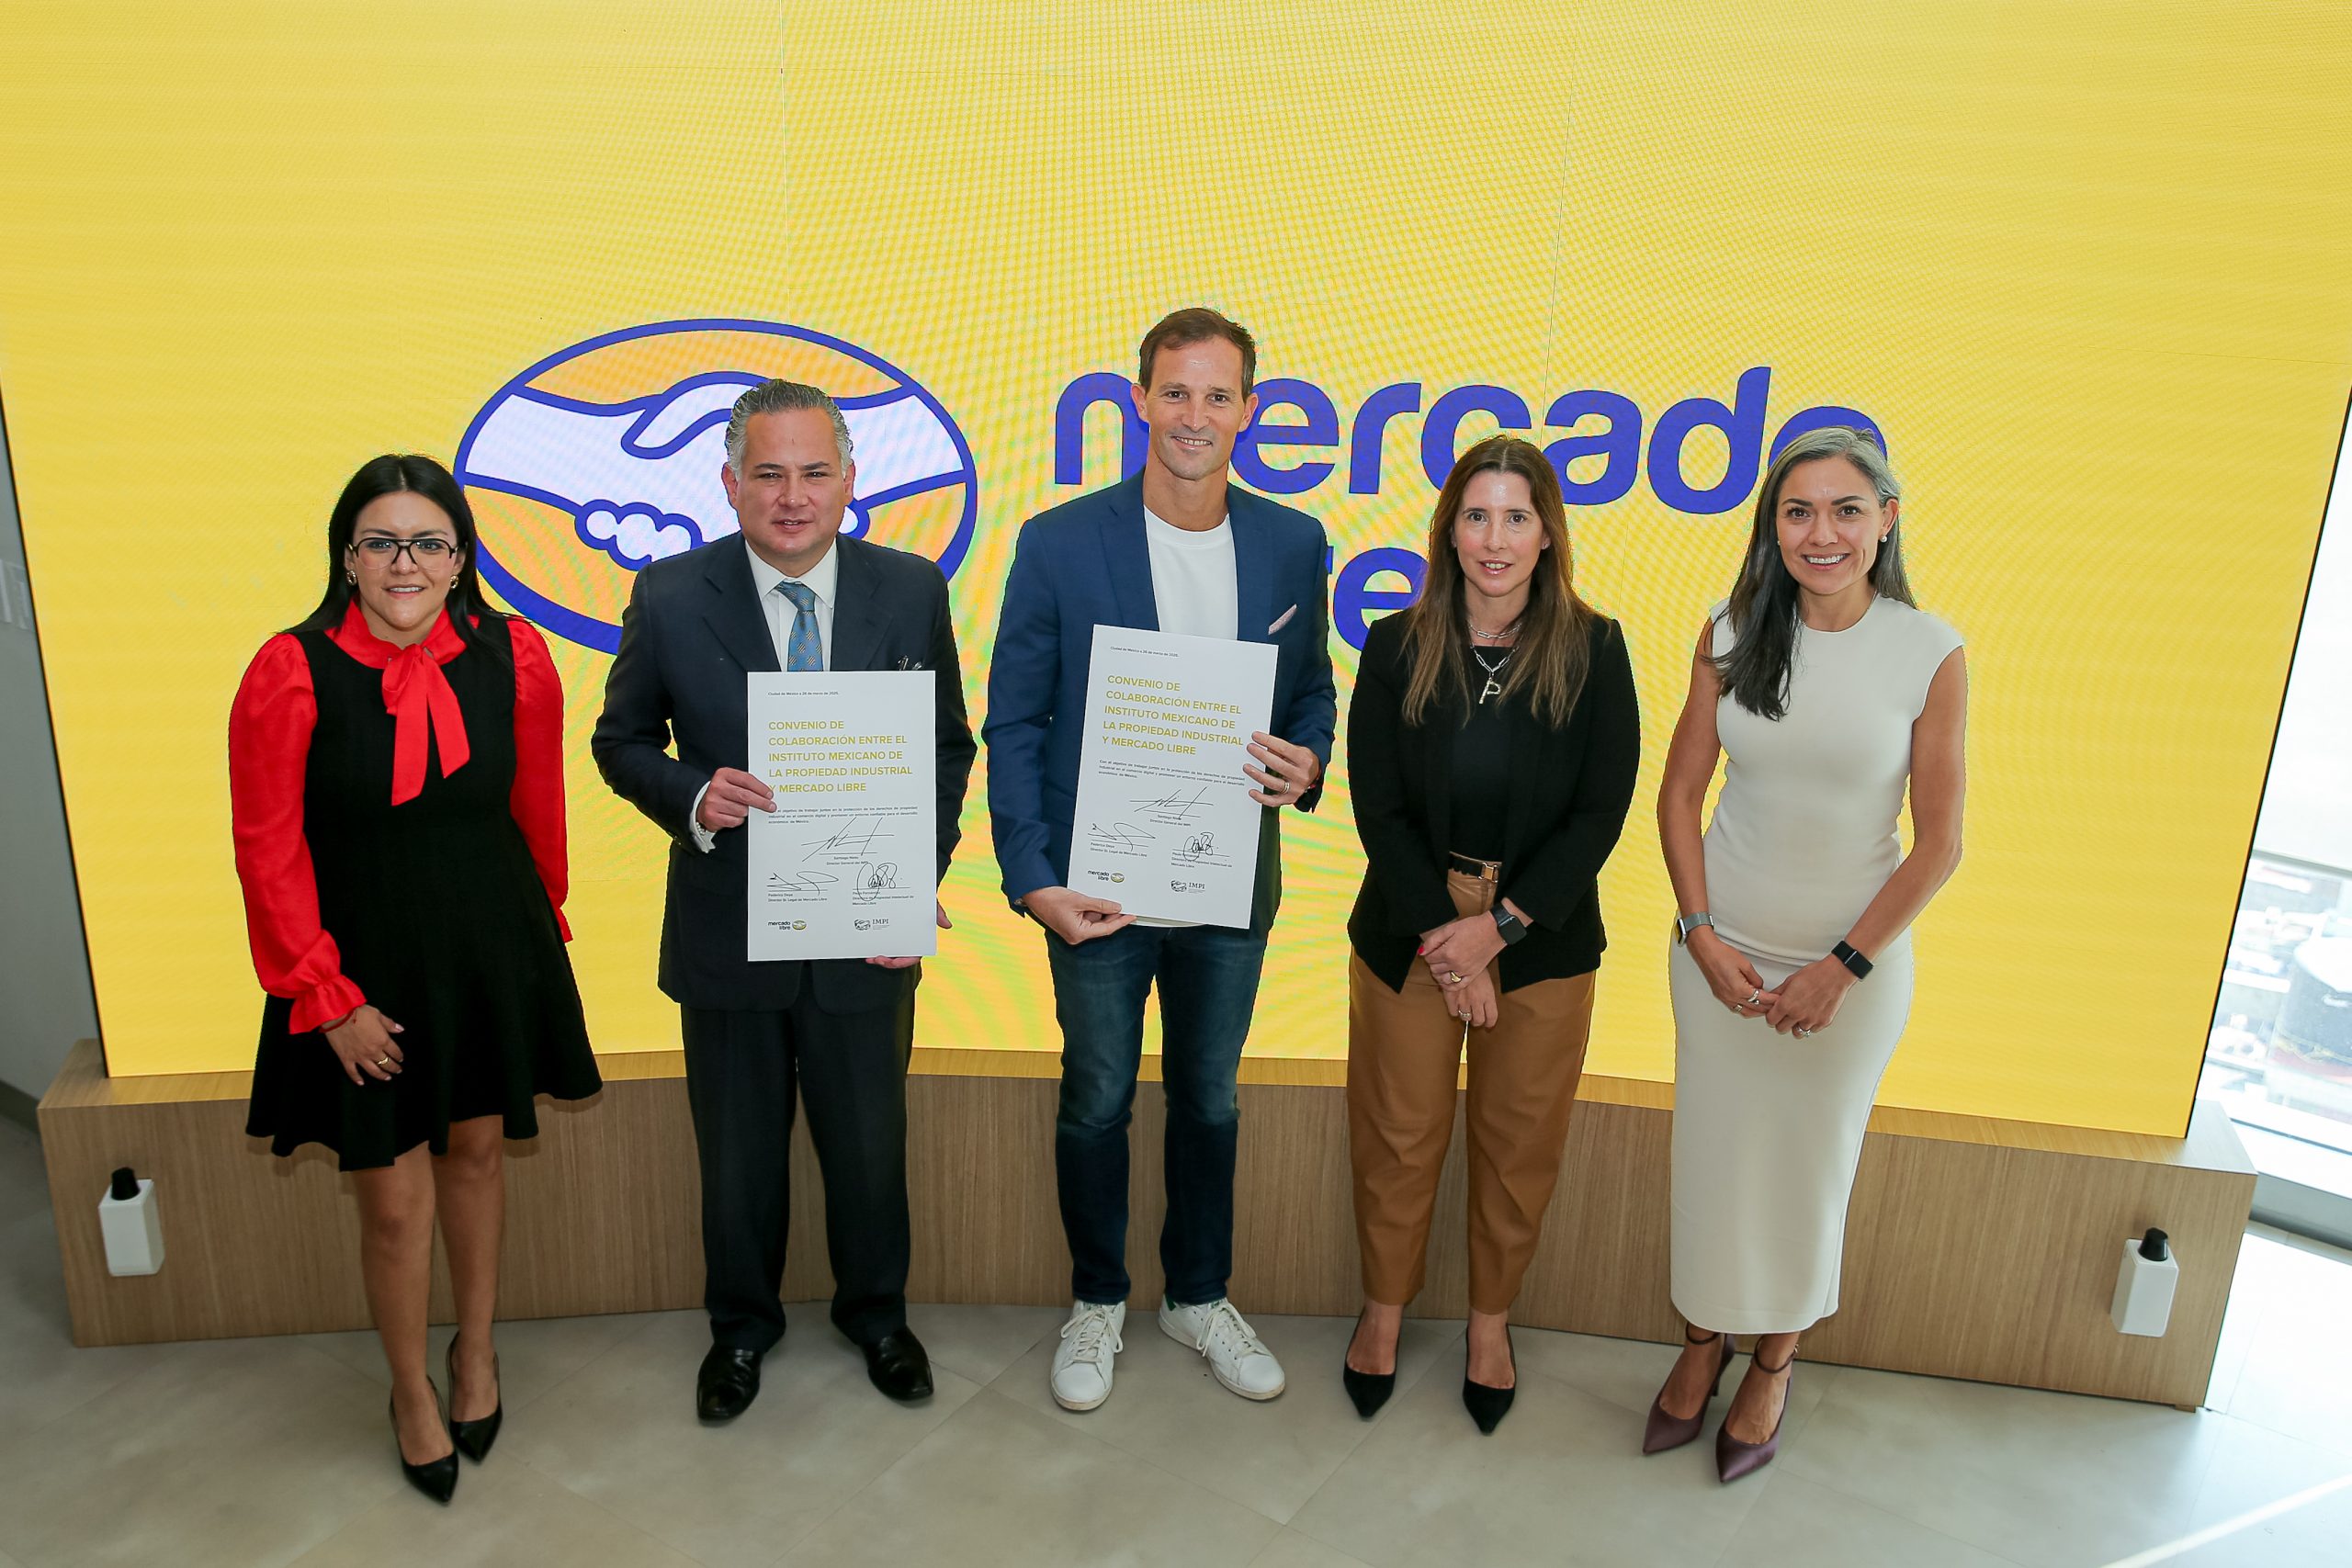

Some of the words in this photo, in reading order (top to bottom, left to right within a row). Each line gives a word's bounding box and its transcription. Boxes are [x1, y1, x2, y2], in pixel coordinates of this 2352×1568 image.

[1107, 675, 1163, 689] CONVENIO
[1167, 682, 1181, 691] DE
[1106, 691, 1190, 708] COLABORACIÓN
[1193, 701, 1227, 712] ENTRE
[1229, 705, 1241, 714] EL
[1105, 705, 1159, 719] INSTITUTO
[1161, 713, 1218, 727] MEXICANO
[1222, 720, 1236, 728] DE
[769, 721, 826, 729] CONVENIO
[768, 735, 855, 745] COLABORACIÓN
[859, 736, 892, 744] ENTRE
[896, 736, 907, 744] EL
[1103, 721, 1115, 730] LA
[1119, 723, 1179, 738] PROPIEDAD
[1182, 730, 1243, 746] INDUSTRIAL
[1102, 736, 1109, 744] Y
[1112, 738, 1164, 750] MERCADO
[1168, 744, 1196, 755] LIBRE
[769, 752, 825, 761] INSTITUTO
[829, 751, 886, 761] MEXICANO
[769, 769, 782, 777] LA
[786, 768, 847, 777] PROPIEDAD
[851, 766, 912, 775] INDUSTRIAL
[779, 784, 833, 793] MERCADO
[838, 783, 866, 792] LIBRE
